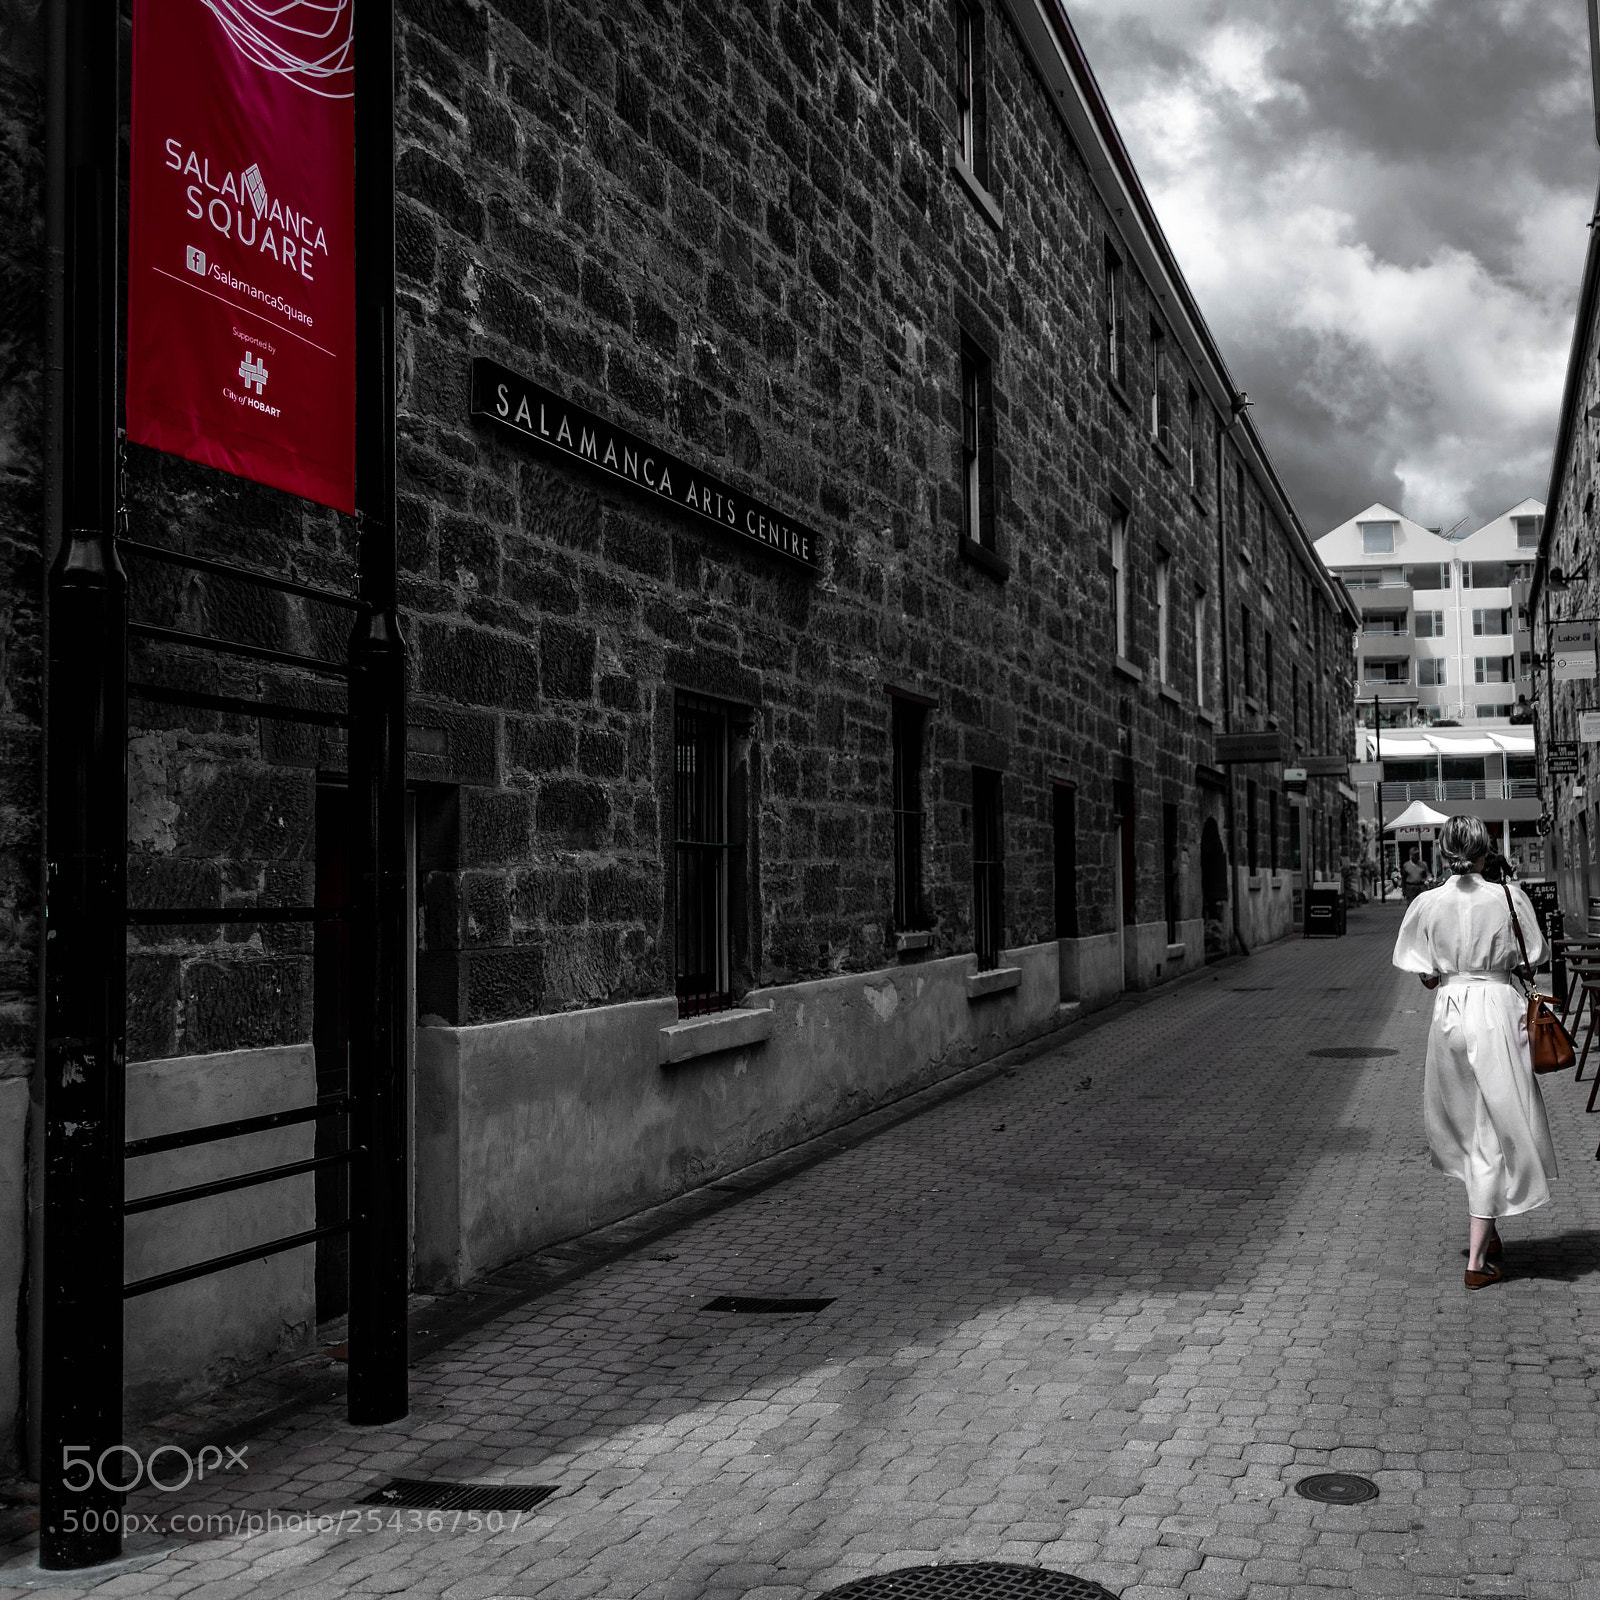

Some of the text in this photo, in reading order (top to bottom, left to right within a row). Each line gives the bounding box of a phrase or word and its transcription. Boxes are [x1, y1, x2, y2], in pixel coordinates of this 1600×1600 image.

[165, 138, 328, 256] SALAMANCA
[186, 185, 314, 281] SQUARE
[232, 325, 276, 355] Supported by
[222, 386, 281, 419] City of HOBART
[496, 383, 809, 561] SALAMANCA ARTS CENTRE
[1558, 634, 1581, 643] Labor
